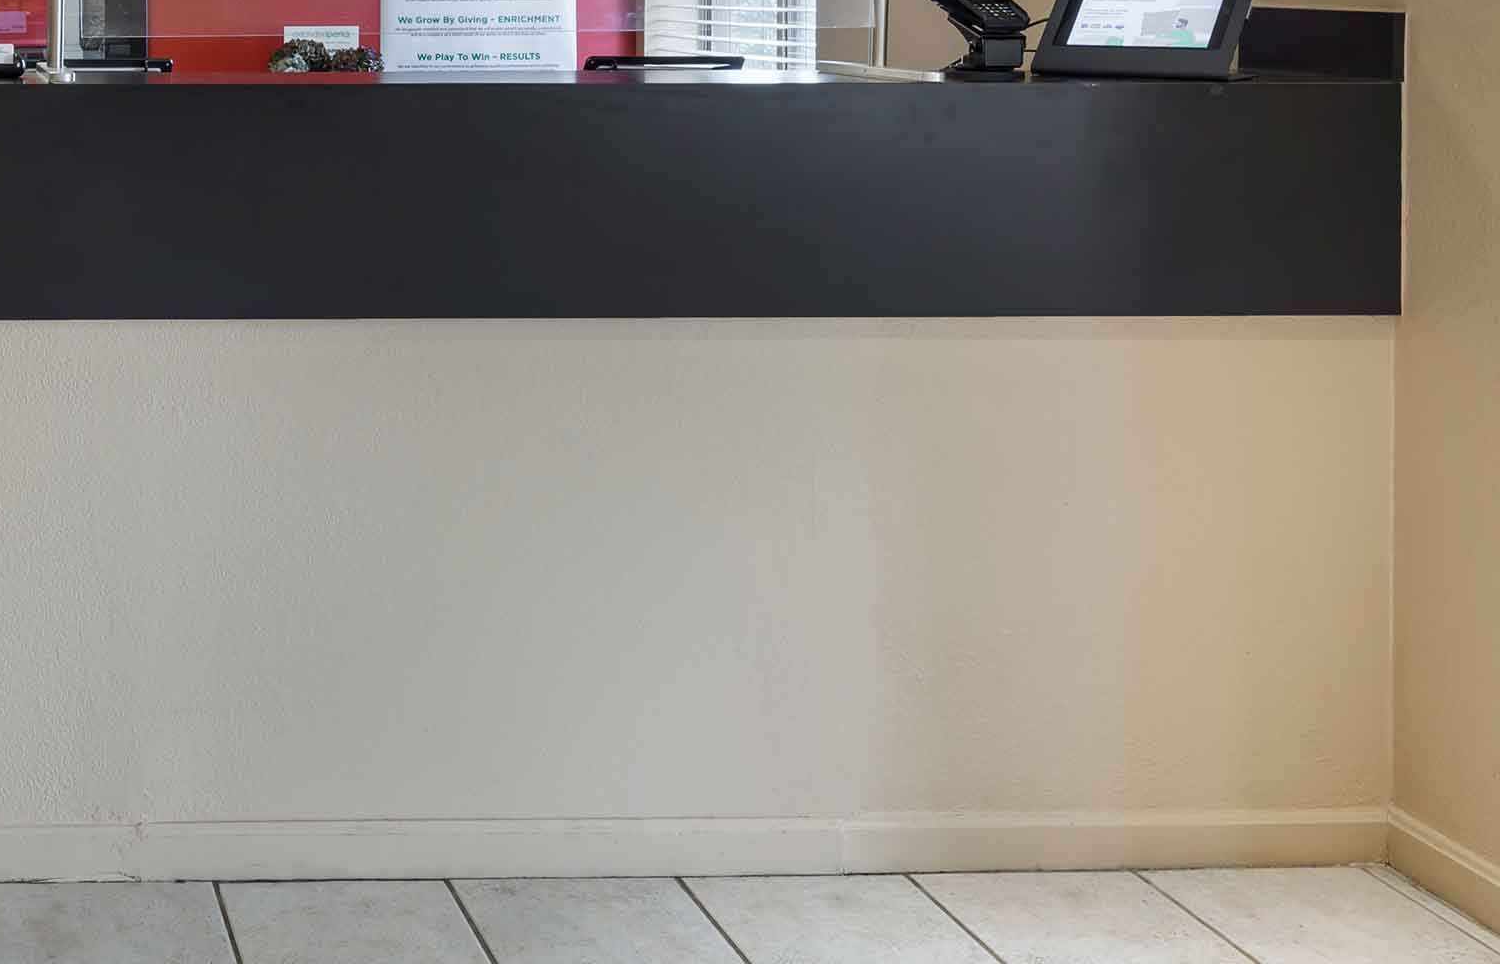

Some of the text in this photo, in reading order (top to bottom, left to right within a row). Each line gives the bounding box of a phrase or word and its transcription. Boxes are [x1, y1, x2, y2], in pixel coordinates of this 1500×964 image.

[398, 16, 413, 24] We
[415, 16, 440, 24] Grow
[443, 16, 455, 26] By
[458, 15, 488, 26] Giving
[498, 15, 560, 23] ENRICHMENT
[417, 53, 432, 61] We
[435, 52, 455, 62] Play
[458, 53, 468, 61] To
[471, 53, 490, 61] Win
[500, 52, 541, 61] RESULTS
